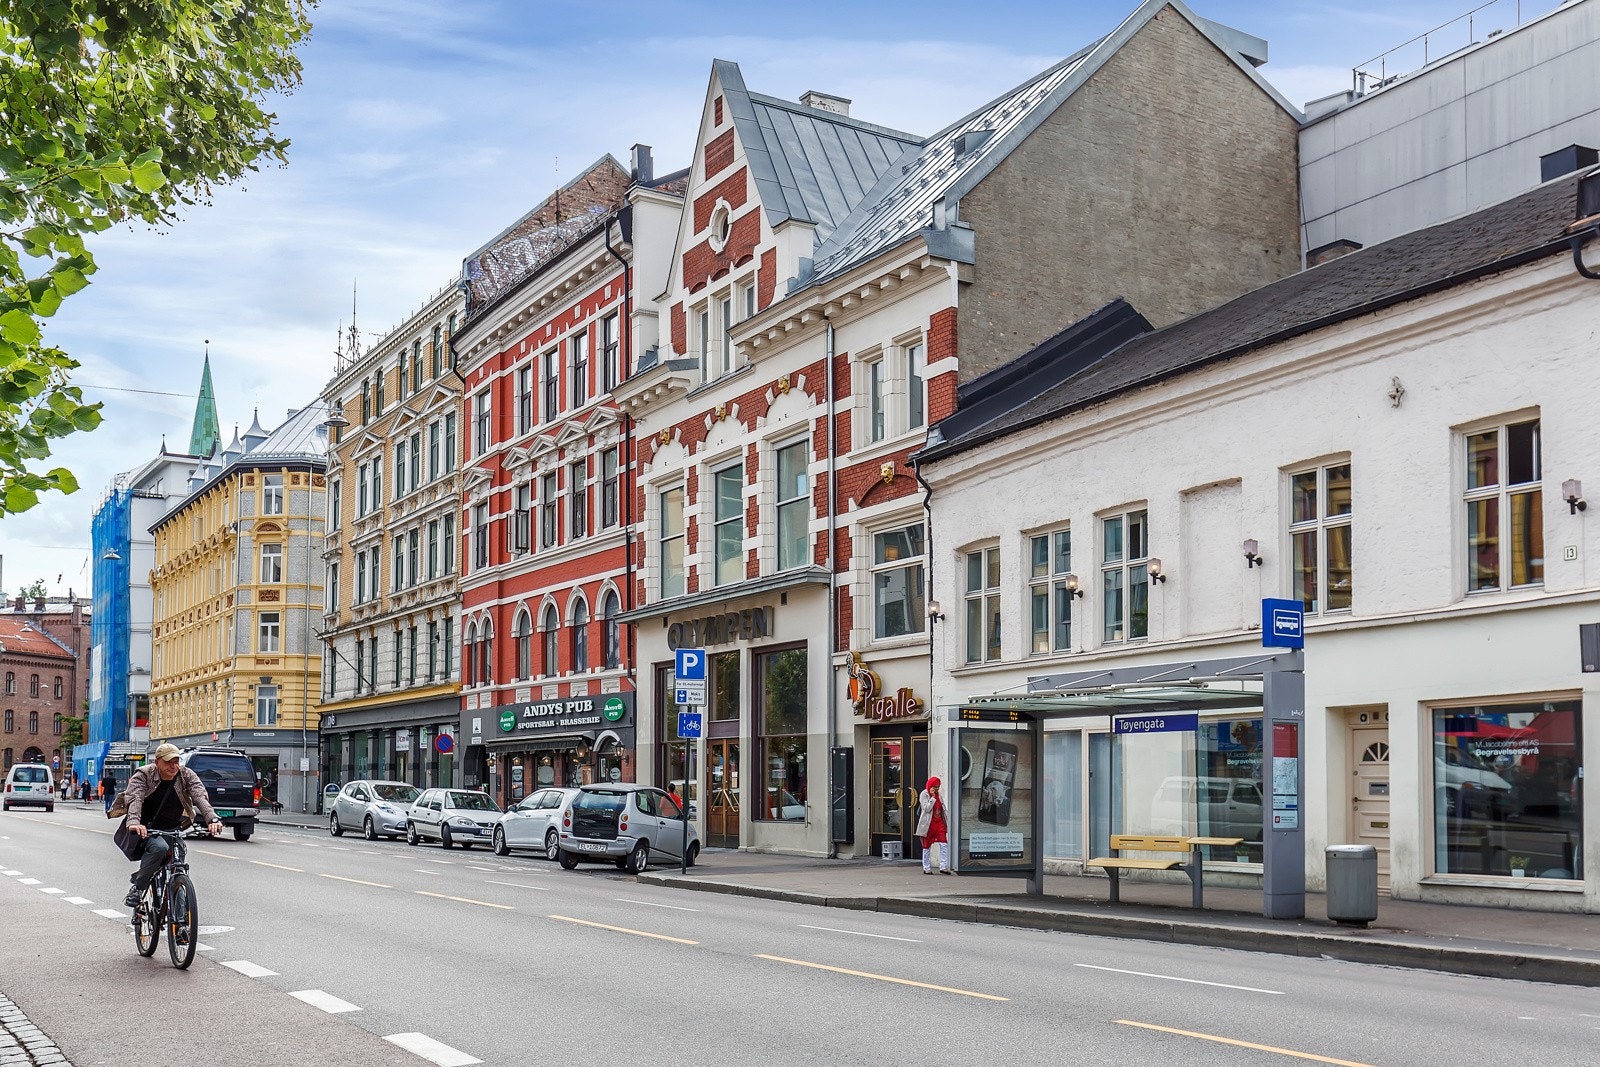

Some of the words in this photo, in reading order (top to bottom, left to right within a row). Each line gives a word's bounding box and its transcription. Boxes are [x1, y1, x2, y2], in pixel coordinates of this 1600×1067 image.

[1566, 547, 1575, 558] 13
[667, 606, 773, 651] OLYMPEN
[683, 653, 698, 675] P
[862, 668, 920, 722] Pigalle
[523, 702, 563, 718] ANDYS
[566, 699, 594, 714] PUB
[517, 720, 555, 730] SPORTSBAR
[560, 716, 601, 726] BRASSERIE
[1118, 717, 1165, 732] Tøyengata
[1475, 747, 1539, 757] Begravelsesbyrå
